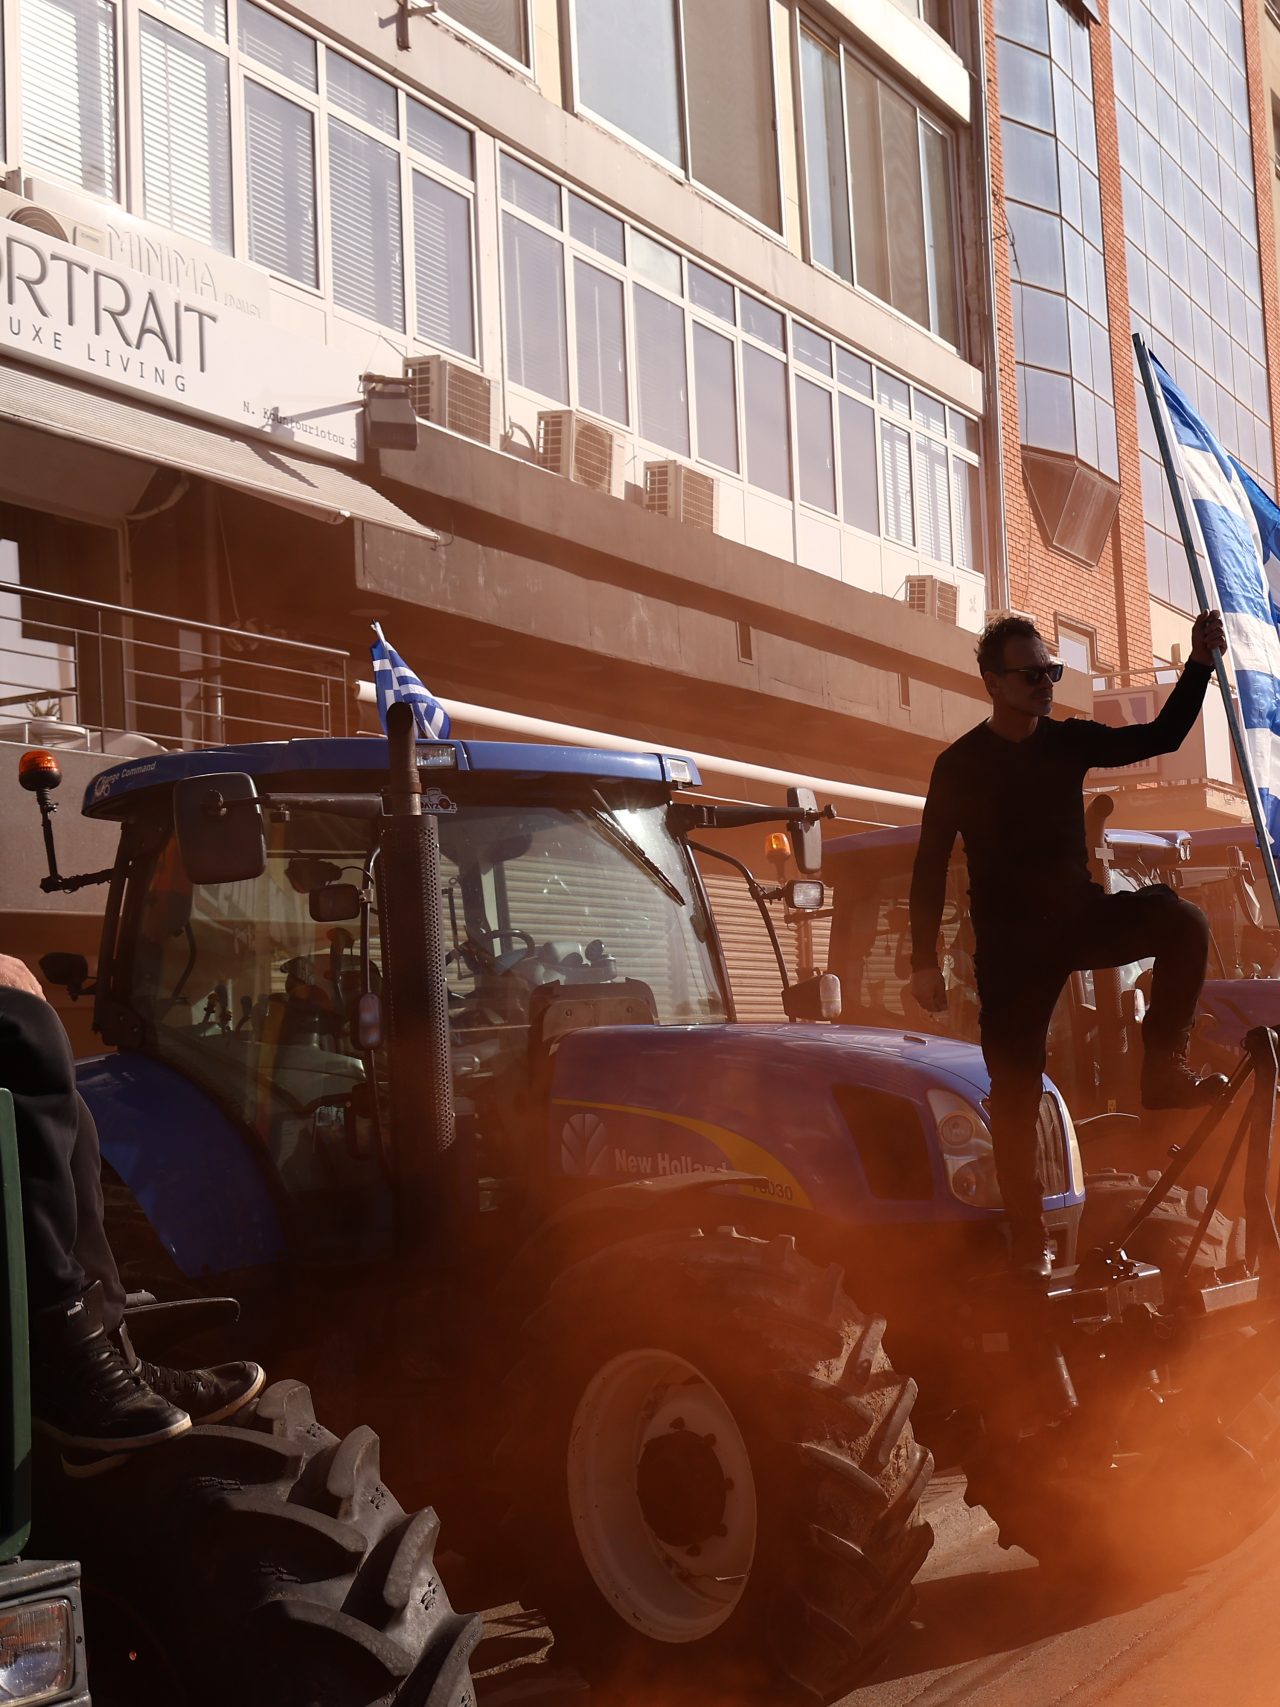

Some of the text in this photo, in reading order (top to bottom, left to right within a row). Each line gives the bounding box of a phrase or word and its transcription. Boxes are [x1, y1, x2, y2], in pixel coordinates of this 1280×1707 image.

[0, 232, 218, 374] RTRAIT
[87, 343, 186, 392] LIVING
[243, 400, 255, 415] N.
[121, 761, 157, 778] Command
[615, 1148, 651, 1174] New
